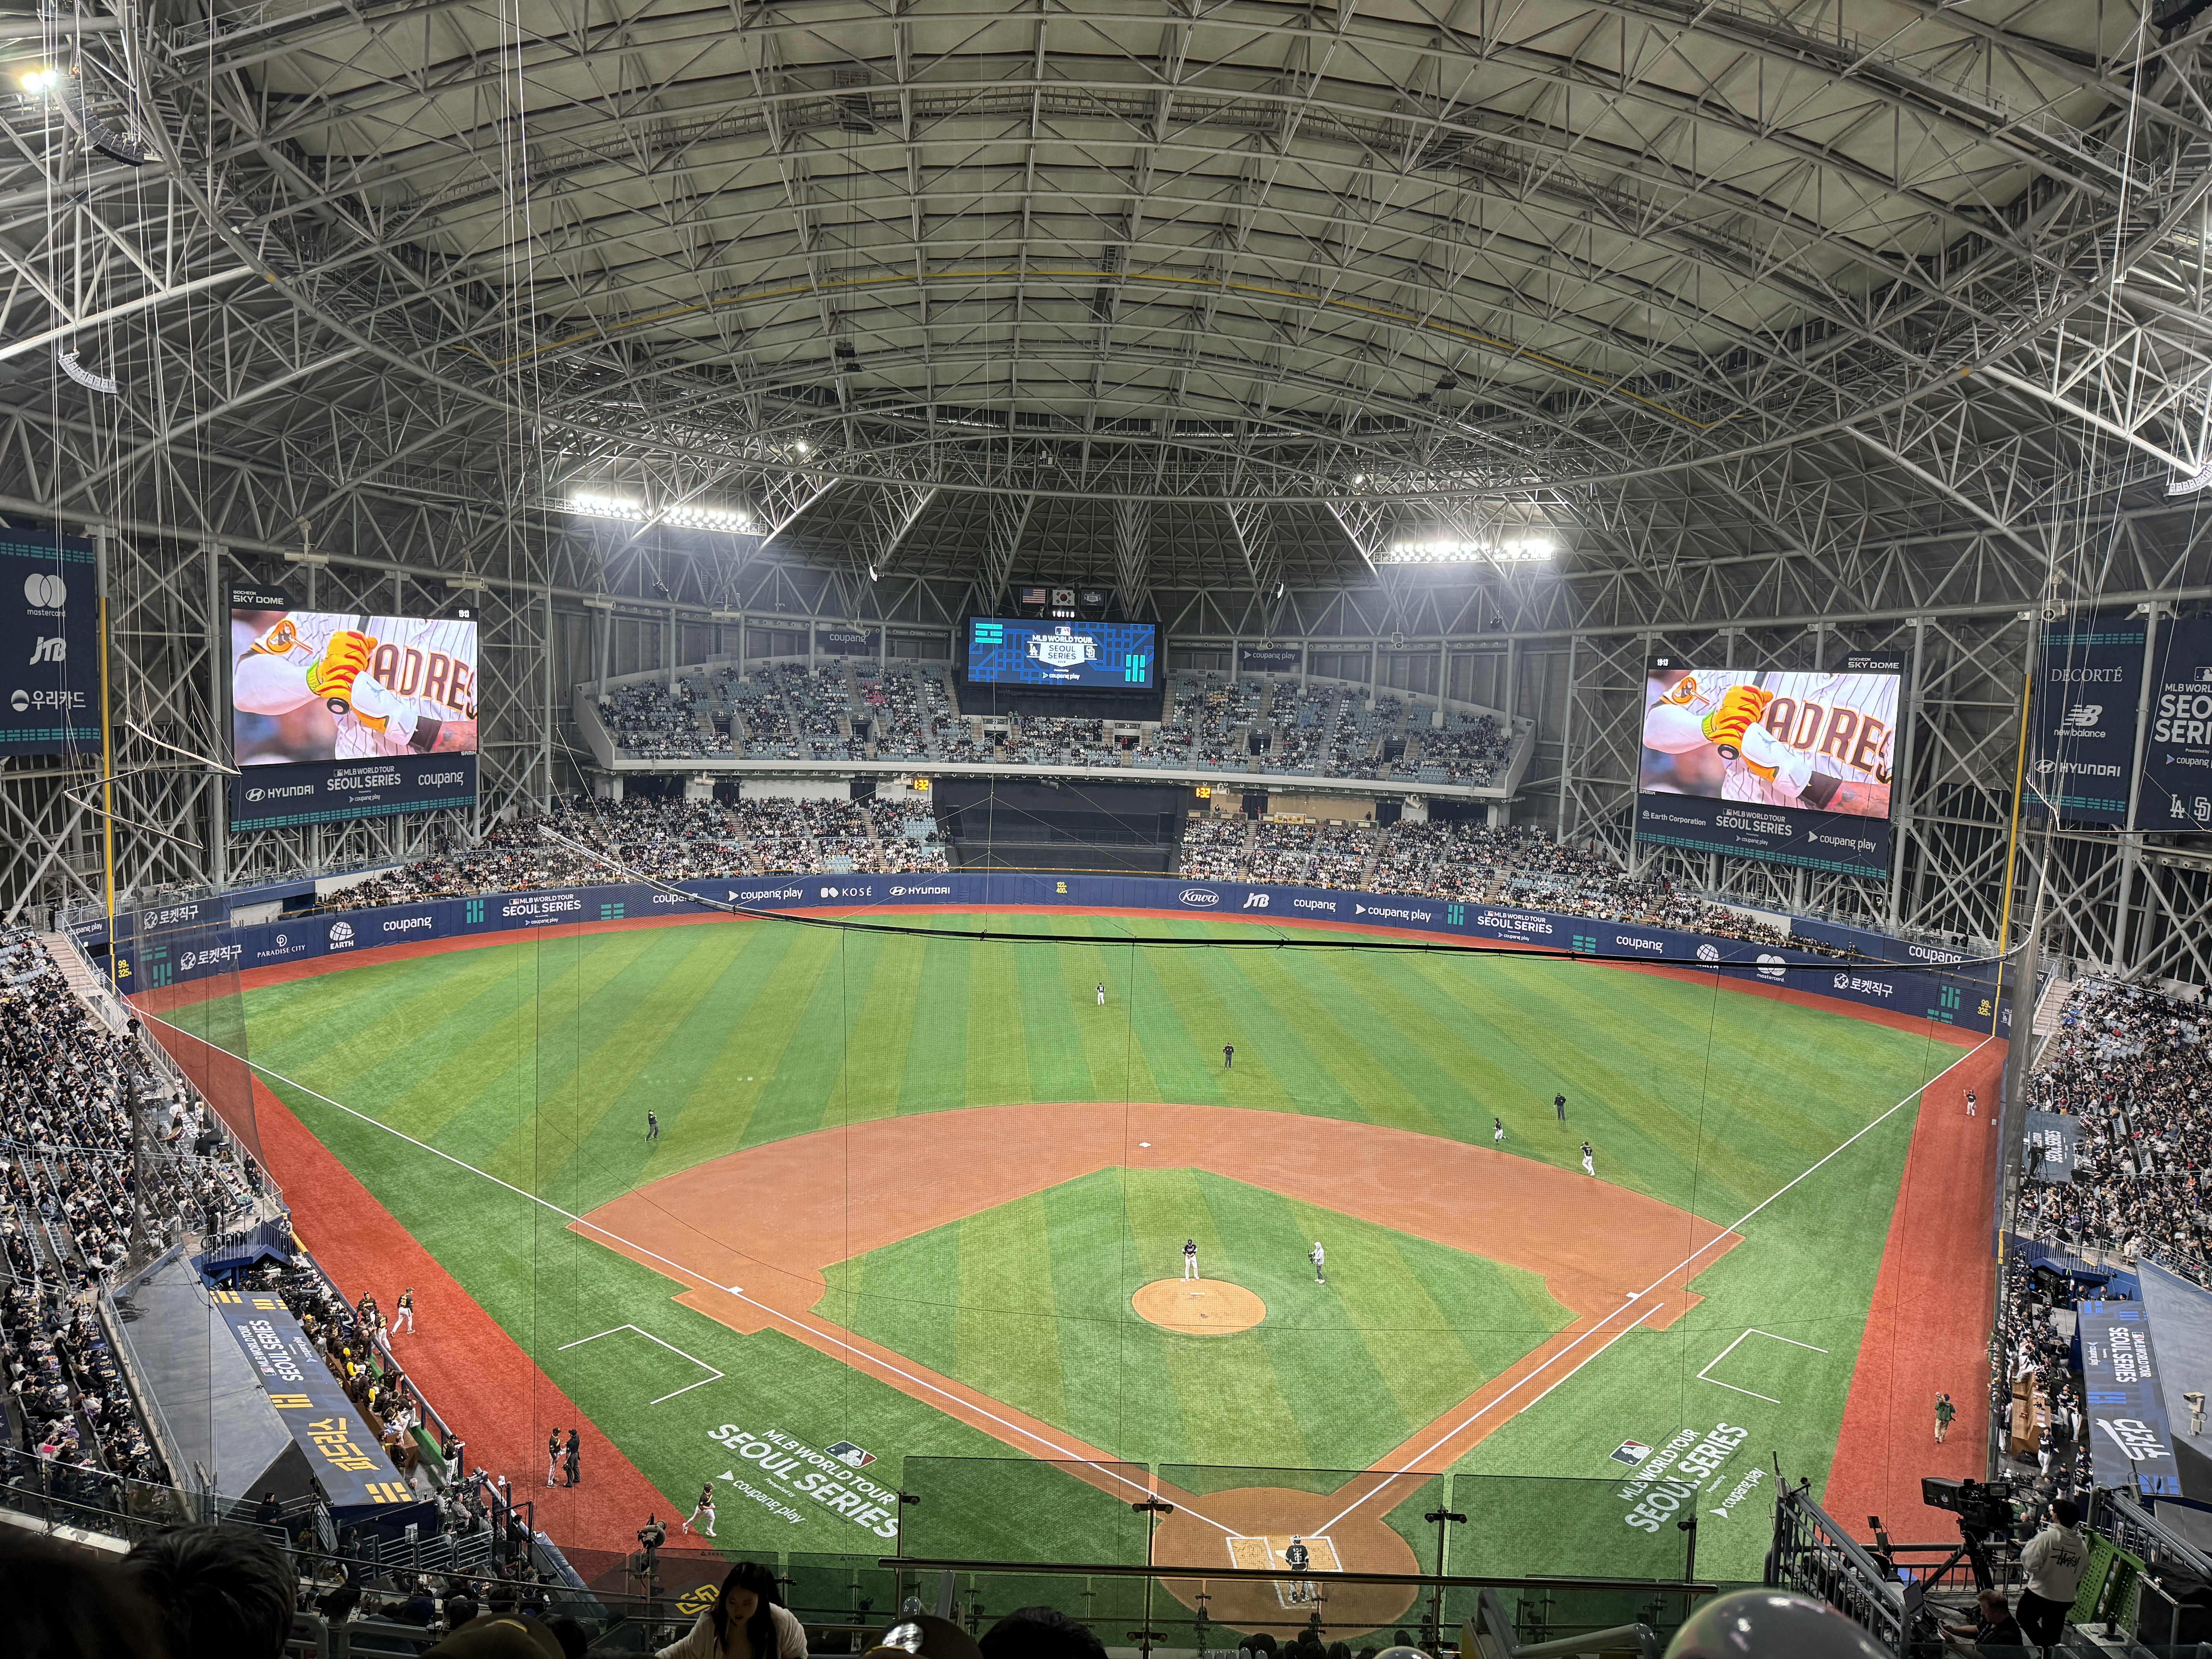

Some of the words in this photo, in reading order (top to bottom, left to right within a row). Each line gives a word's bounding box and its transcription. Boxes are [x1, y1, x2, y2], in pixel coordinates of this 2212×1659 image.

[256, 596, 283, 605] DOME
[27, 609, 66, 617] mastercard
[829, 632, 866, 645] coupang
[29, 636, 67, 665] JTB
[1252, 651, 1279, 662] coupang
[1281, 651, 1295, 661] play
[2050, 666, 2123, 682] DECORTÉ
[2165, 683, 2185, 692] MLB
[31, 690, 86, 710] 우리카드
[2072, 729, 2106, 738] balance
[2060, 763, 2120, 777] HYUNDAI
[2176, 757, 2210, 768] coupang
[327, 776, 363, 791] SEOUL
[365, 773, 401, 787] SERIES
[418, 771, 464, 788] coupang
[268, 785, 314, 799] HYUNDAI
[1651, 812, 1667, 821] Earth
[1669, 815, 1706, 826] Corporation
[1745, 811, 1768, 820] WORLD
[1716, 816, 1752, 831] SEOUL
[1753, 821, 1793, 836] SERIES
[1741, 837, 1759, 845] coupang
[1820, 834, 1856, 850] coupang
[1857, 838, 1877, 852] play
[741, 889, 782, 901] coupang
[783, 887, 803, 902] play
[842, 886, 872, 896] KOSÉ
[908, 886, 950, 895] HYUNDAI
[1182, 891, 1217, 903] Kowa
[503, 904, 540, 917] SEOUL
[542, 900, 581, 913] SERIES
[1243, 893, 1270, 908] JTB
[1293, 898, 1336, 912] coupang
[159, 904, 199, 925] 로켓직구
[1368, 906, 1409, 921] coupang
[1411, 909, 1431, 923] play
[1507, 913, 1529, 921] WORLD
[67, 925, 91, 935] coupang
[91, 922, 102, 932] play
[383, 916, 432, 932] coupang
[1477, 915, 1513, 929] SEOUL
[1515, 921, 1553, 934] SERIES
[257, 947, 290, 958] PARADISE
[291, 945, 306, 953] CITY
[330, 940, 354, 950] EARTH
[1616, 936, 1663, 954] coupang
[198, 944, 242, 965] 로켓직구
[1757, 973, 1784, 982] mastercard
[1850, 977, 1893, 998] 로켓직구
[2044, 1130, 2062, 1147] SERIES
[237, 1325, 254, 1338] TOUR
[249, 1320, 284, 1350] SERIES
[244, 1338, 264, 1356] WORLD
[2108, 1327, 2132, 1353] SEOUL
[2133, 1338, 2144, 1348] MLB
[255, 1356, 271, 1367] MLB
[2137, 1348, 2149, 1365] WORLD
[268, 1350, 304, 1381] SEOUL
[2112, 1353, 2138, 1383] SERIES
[2138, 1365, 2152, 1377] TOUR
[307, 1417, 381, 1472] 파드리스
[2095, 1418, 2171, 1461] 다저스
[761, 1429, 800, 1450] MLB
[793, 1446, 853, 1481] WORLD
[849, 1475, 896, 1506] TOUR
[1617, 1479, 1649, 1501] MLB
[1635, 1446, 1679, 1482] WORLD
[1672, 1428, 1700, 1451] TOUR
[707, 1424, 802, 1480] SEOUL
[793, 1473, 898, 1538] SERIES
[1625, 1475, 1702, 1533] SEOUL
[1678, 1422, 1748, 1478] SERIES
[764, 1478, 790, 1495] Presented
[1705, 1479, 1721, 1493] Presented
[1722, 1481, 1753, 1508] coupang
[1745, 1467, 1768, 1485] play
[732, 1480, 781, 1510] coupang
[773, 1506, 806, 1524] play
